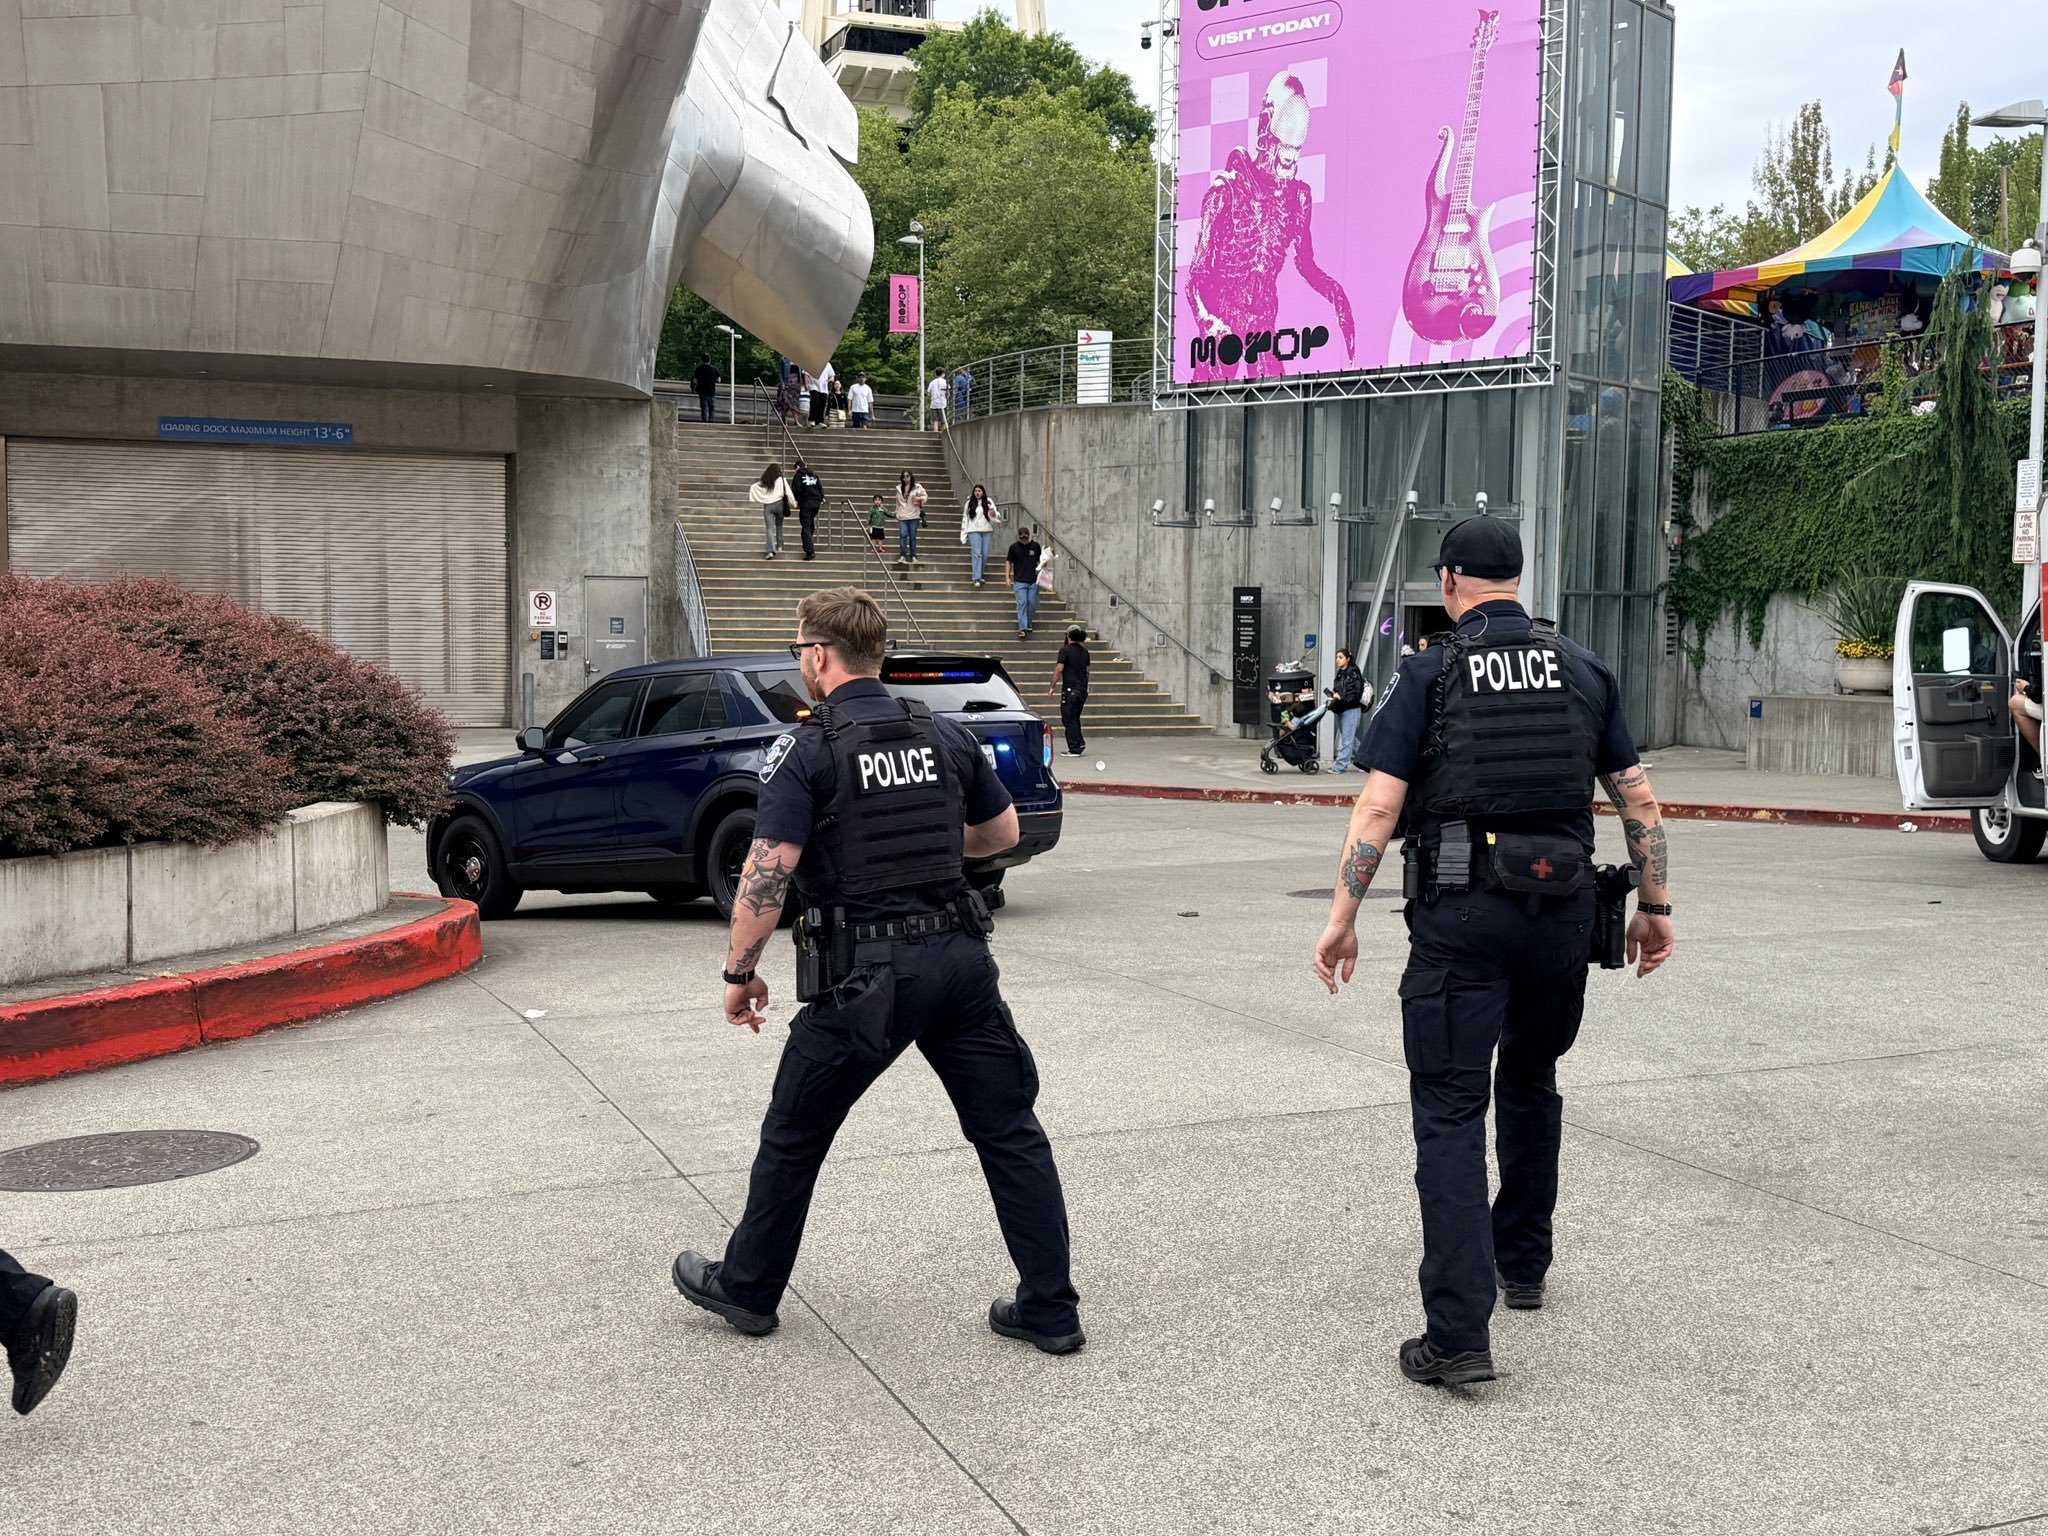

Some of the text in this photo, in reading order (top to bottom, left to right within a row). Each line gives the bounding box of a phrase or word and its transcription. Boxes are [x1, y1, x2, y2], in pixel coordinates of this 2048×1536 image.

[1207, 13, 1331, 48] VISIT TODAY!
[161, 423, 350, 439] LOADING DOCK MAXIMUM HEIGHT 13'-6"
[1468, 649, 1561, 692] POLICE
[858, 747, 938, 789] POLICE
